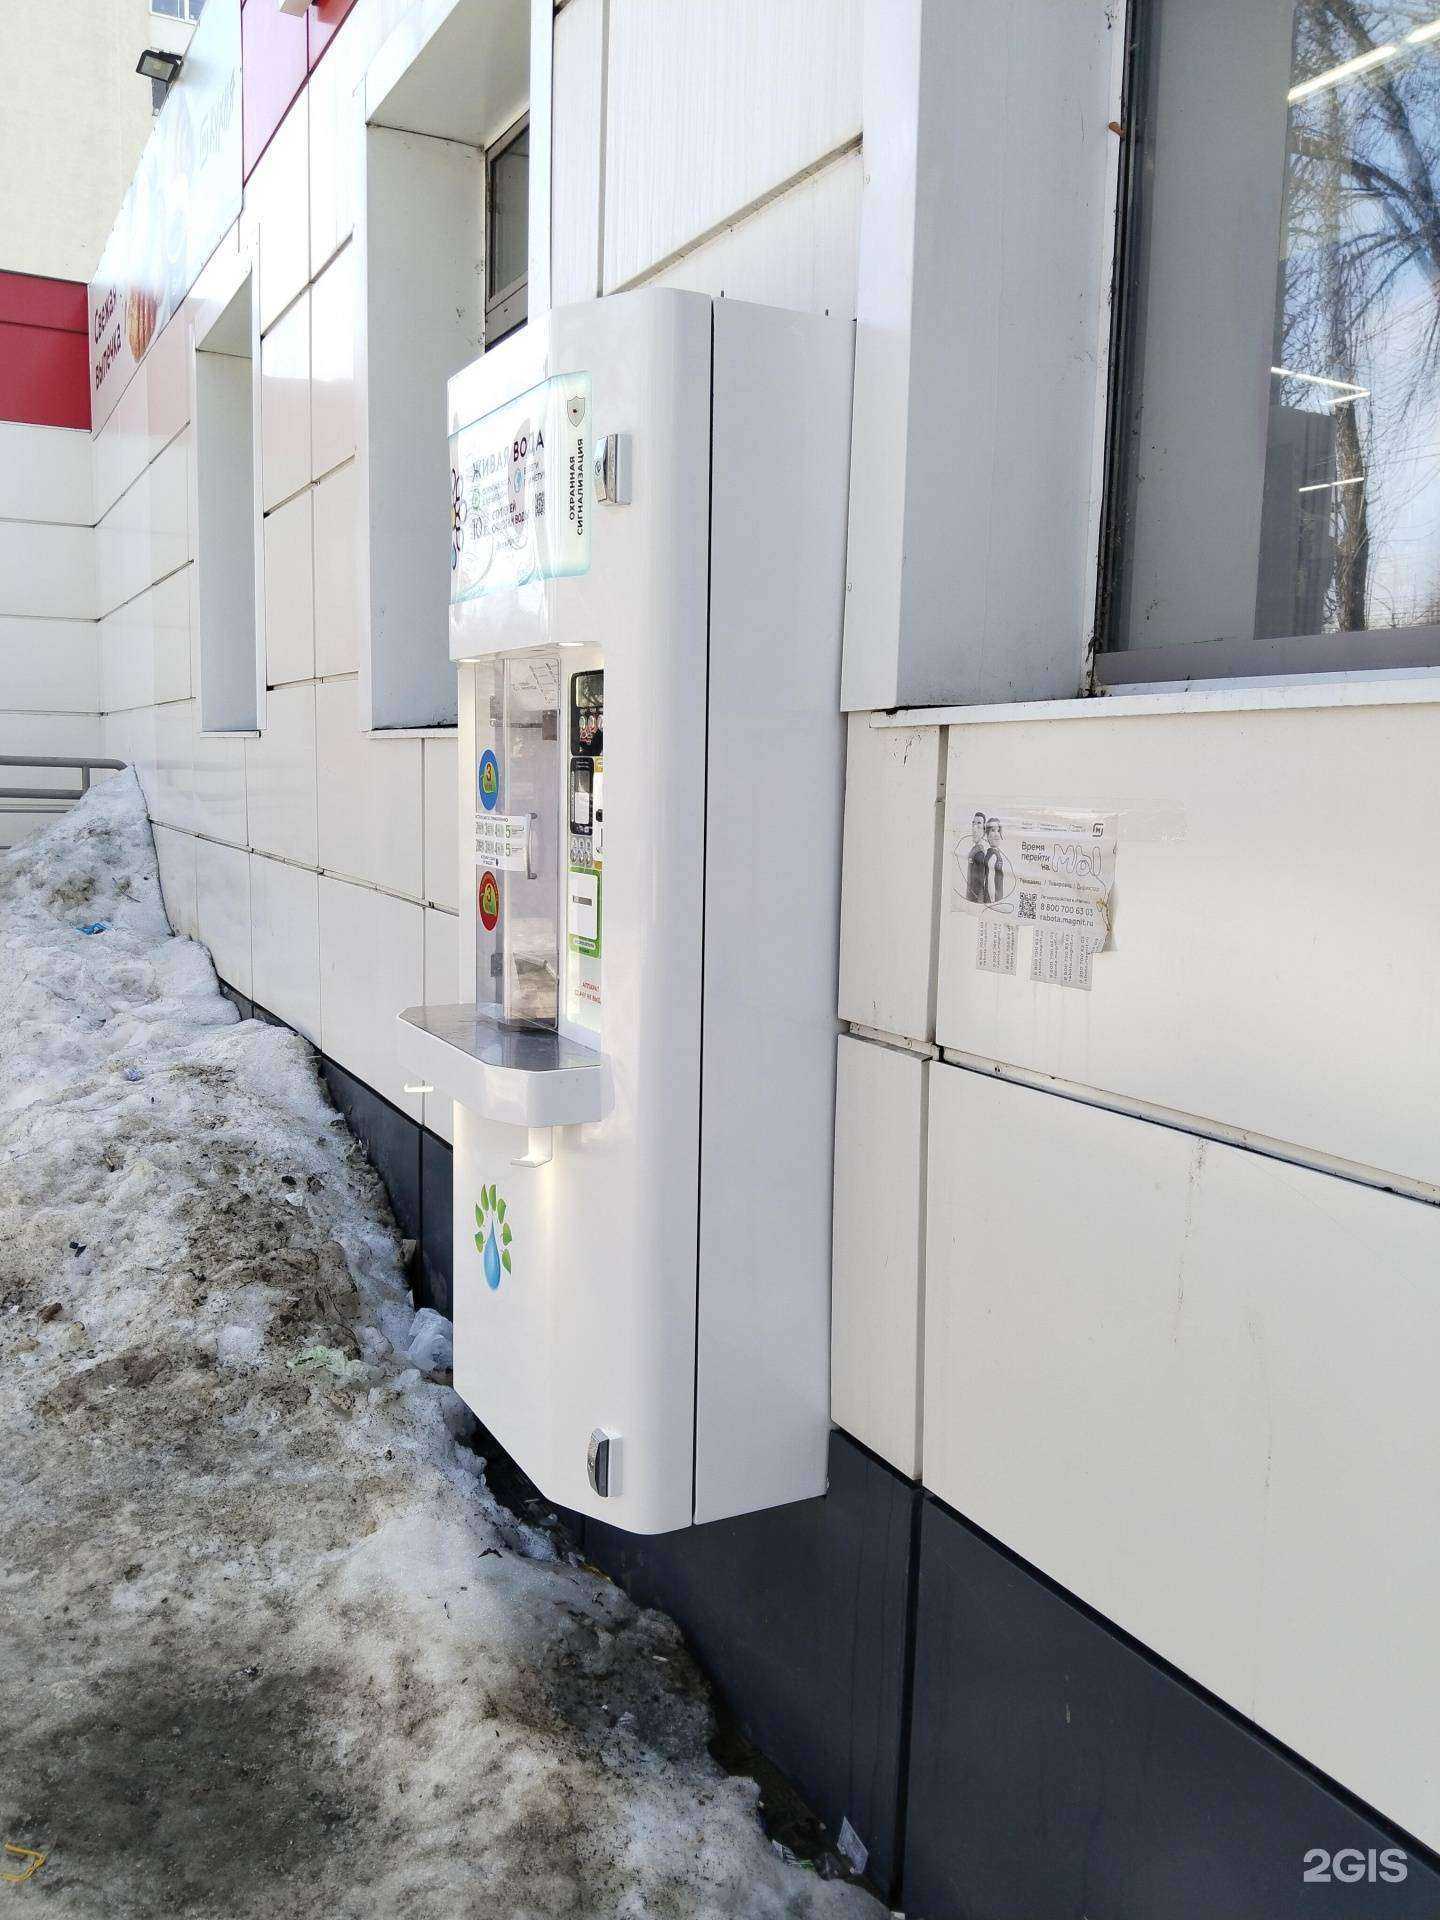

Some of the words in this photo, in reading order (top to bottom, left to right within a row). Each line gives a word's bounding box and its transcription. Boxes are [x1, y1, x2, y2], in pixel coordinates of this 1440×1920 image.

[576, 438, 585, 536] СИГНАЛИЗАЦИЯ
[1021, 841, 1045, 852] Время
[1021, 852, 1050, 863] перейти
[1041, 863, 1051, 871] на
[1046, 903, 1060, 912] 800
[1061, 905, 1074, 914] 700
[1085, 908, 1094, 917] 03
[1040, 913, 1094, 927] rabota.magnit.ru
